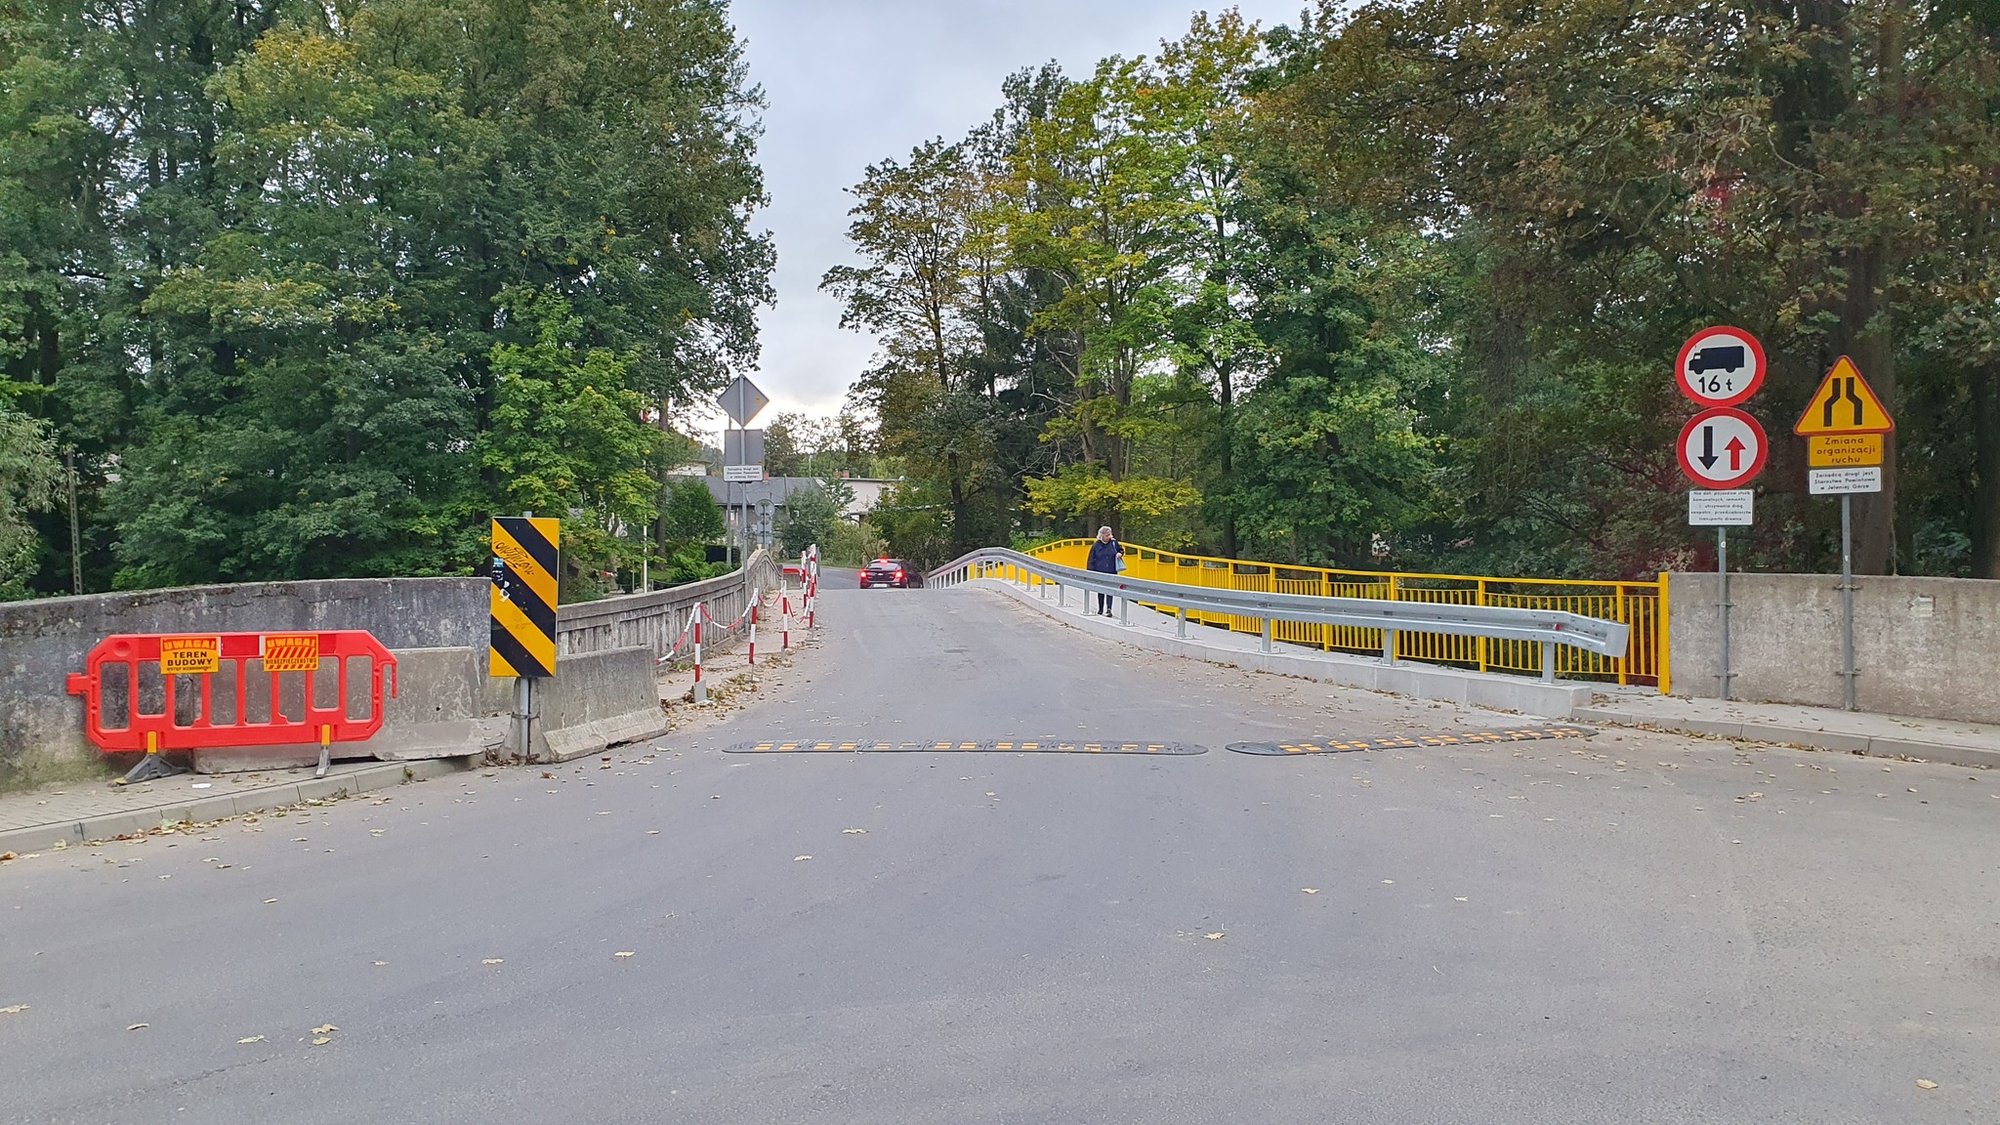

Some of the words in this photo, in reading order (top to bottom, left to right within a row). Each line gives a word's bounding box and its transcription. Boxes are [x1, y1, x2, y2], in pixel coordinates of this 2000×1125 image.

[1698, 375, 1721, 394] 16
[1726, 378, 1733, 392] t
[1824, 437, 1864, 446] Zmiana
[1816, 445, 1876, 457] organizacji
[1831, 456, 1861, 464] ruchu
[163, 639, 216, 650] UWAGA!
[266, 638, 316, 648] UWAGA!
[167, 658, 213, 666] BUDOWY
